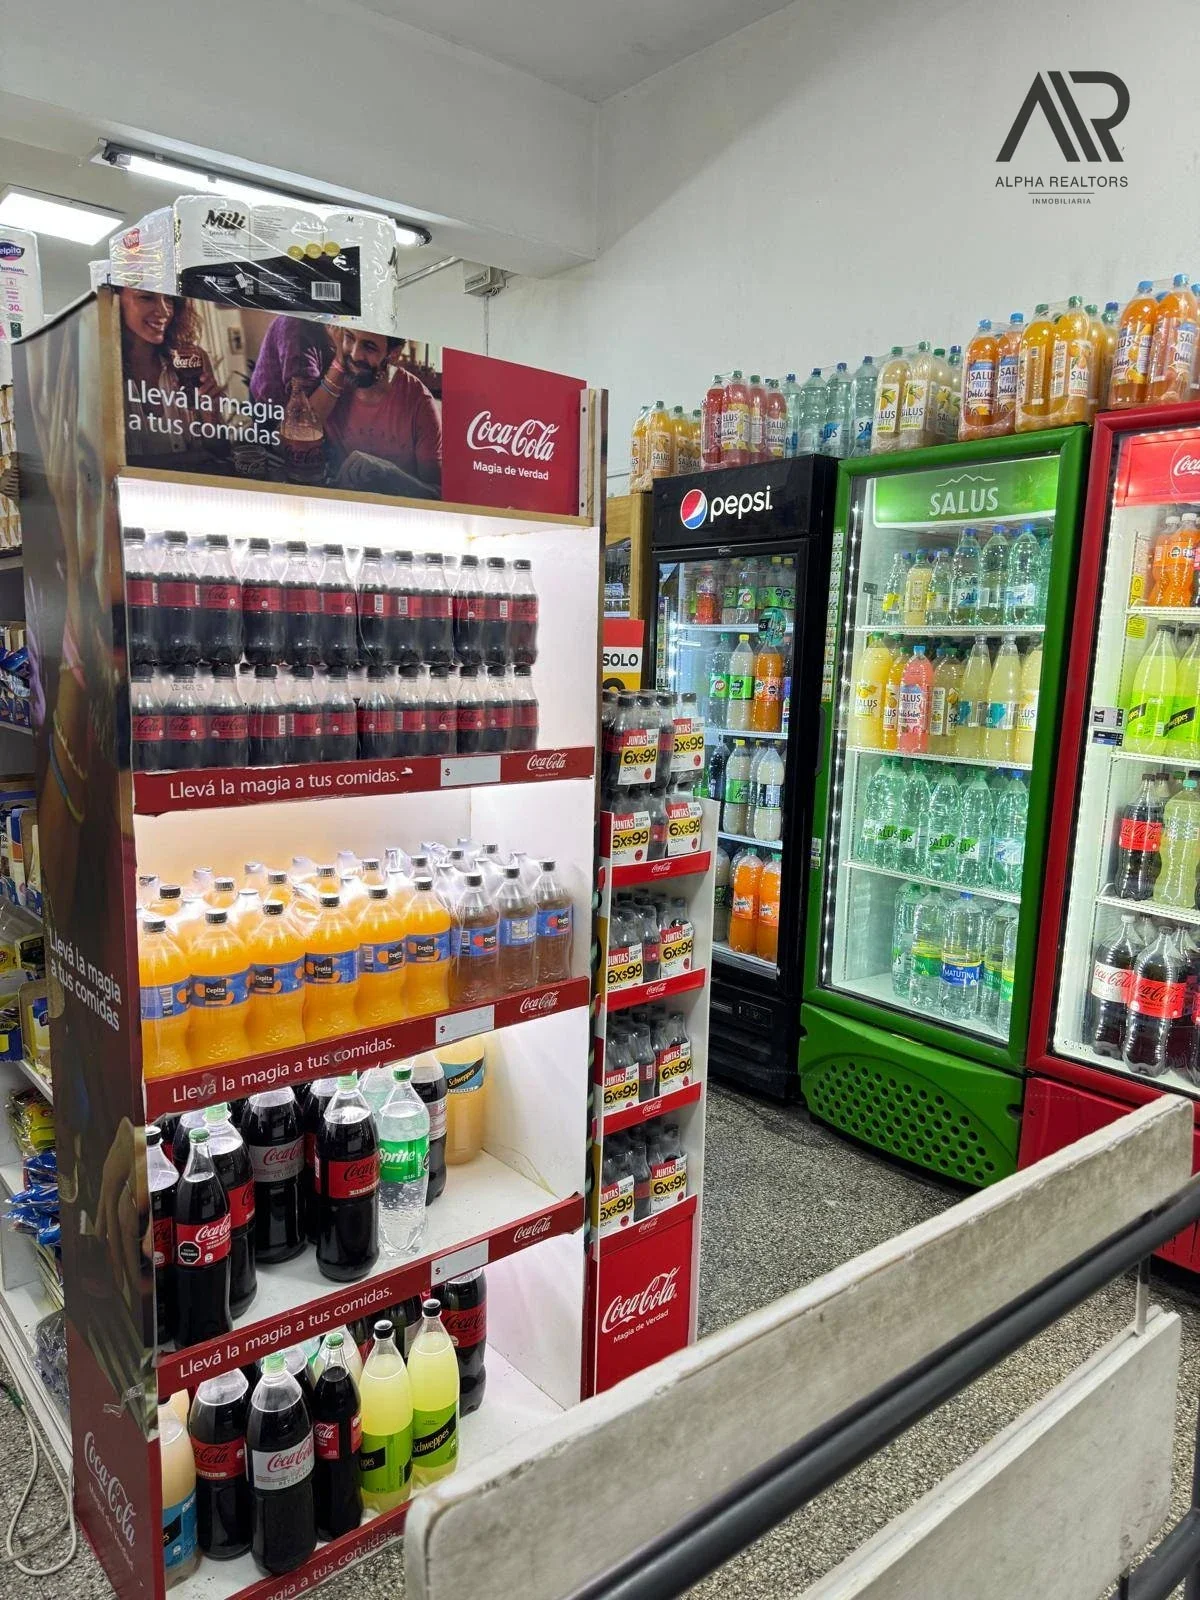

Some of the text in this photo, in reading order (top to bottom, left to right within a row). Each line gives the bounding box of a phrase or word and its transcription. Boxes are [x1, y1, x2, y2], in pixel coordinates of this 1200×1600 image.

[202, 209, 246, 231] Mili
[127, 380, 285, 421] Llevá la magia
[128, 413, 281, 446] a tus comidas
[466, 410, 560, 461] Coca-Cola
[473, 460, 549, 481] Magia de Verdad
[710, 485, 771, 522] pepsi
[929, 487, 999, 517] SALUS
[603, 652, 639, 667] SOLO
[626, 735, 648, 746] JUNTAS
[444, 767, 451, 777] $
[526, 752, 567, 771] Coca-Cola
[169, 768, 400, 799] Llevá la magia a tus comidas.
[669, 808, 690, 819] JUNTAS
[929, 836, 955, 848] SALUS
[663, 930, 683, 943] JUNTAS
[49, 927, 122, 1005] Llevá la magia
[943, 968, 974, 979] MATUTINA
[255, 974, 273, 983] Cepita
[51, 959, 120, 1032] a tus comidas
[205, 986, 225, 995] Cepita
[519, 990, 560, 1014] Coca-Cola
[439, 1025, 446, 1034] $
[663, 1049, 680, 1064] JUNTAS
[172, 1036, 396, 1104] Llevá la magia a tus comidas.
[604, 1072, 625, 1087] JUNTAS
[379, 1147, 416, 1164] Sprite
[654, 1164, 676, 1179] JUNTAS
[512, 1215, 553, 1244] Coca-Cola
[601, 1265, 680, 1334] Coca-Cola
[179, 1286, 394, 1378] Llevá la magia a tus comidas.
[613, 1308, 669, 1344] Magia de Verdad
[413, 1428, 450, 1453] Schweppes
[84, 1431, 137, 1547] Coca-Cola
[300, 1576, 309, 1587] a
[312, 1562, 334, 1581] tus
